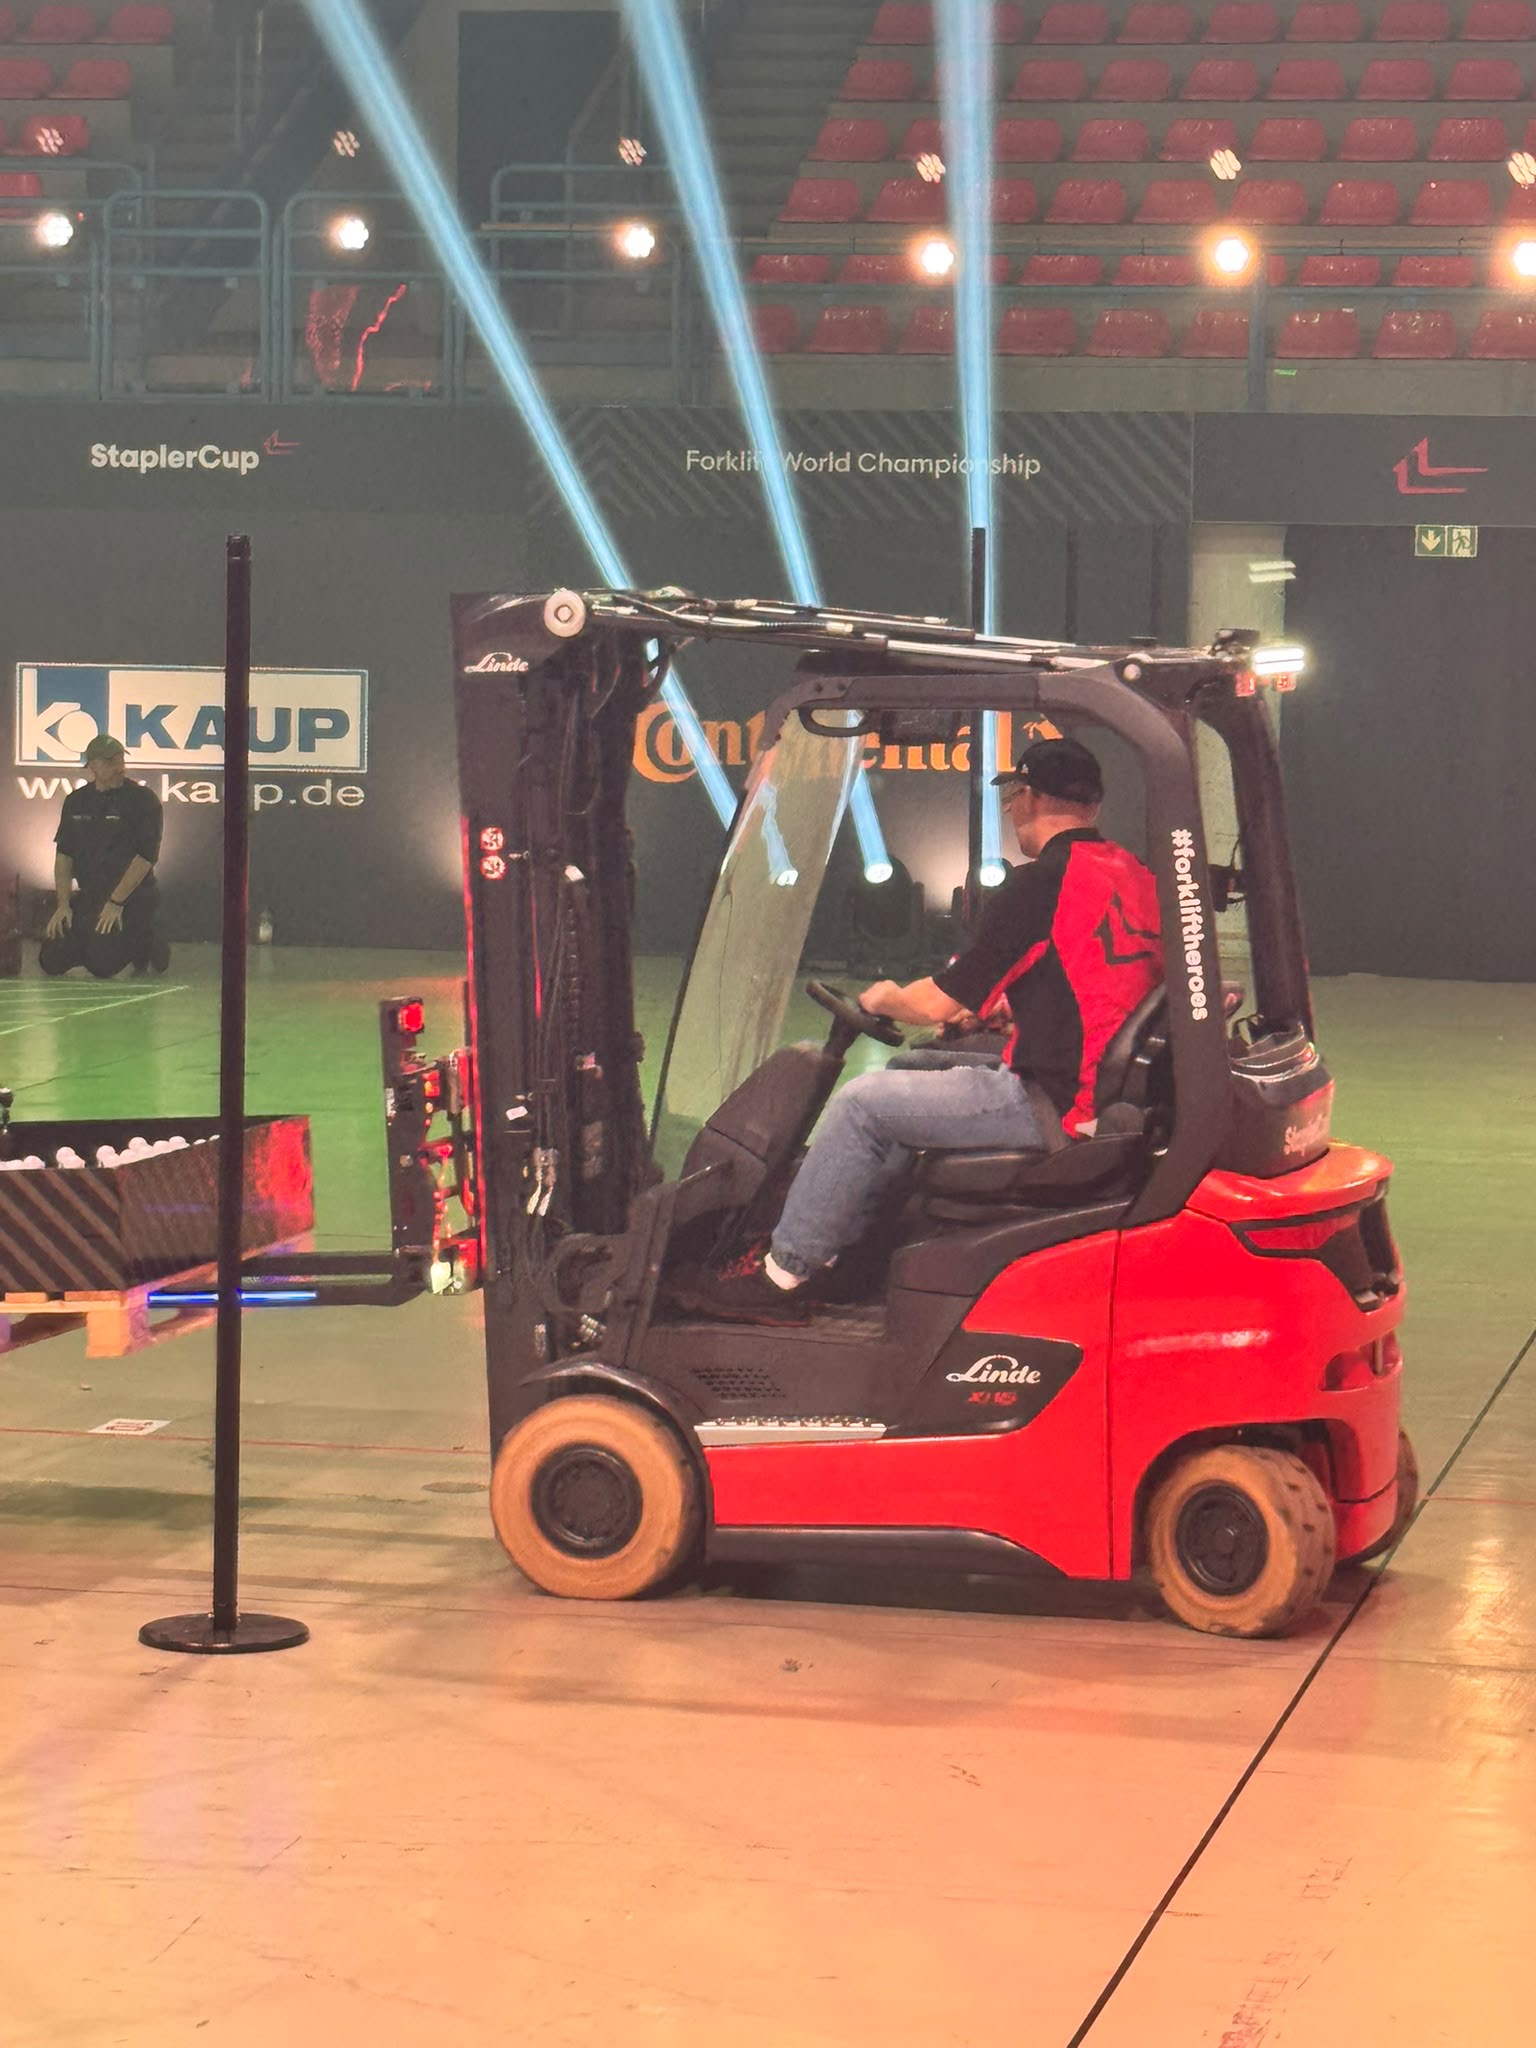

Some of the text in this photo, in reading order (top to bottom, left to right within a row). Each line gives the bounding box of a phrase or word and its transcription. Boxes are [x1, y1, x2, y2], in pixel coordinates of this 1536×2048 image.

[90, 443, 260, 476] StaplerCup
[685, 450, 1042, 480] Forklif World Champioship
[464, 651, 529, 673] Linde
[125, 703, 350, 753] KAUP
[1171, 828, 1208, 1021] #forkliftheroes
[945, 1354, 1041, 1384] Linde
